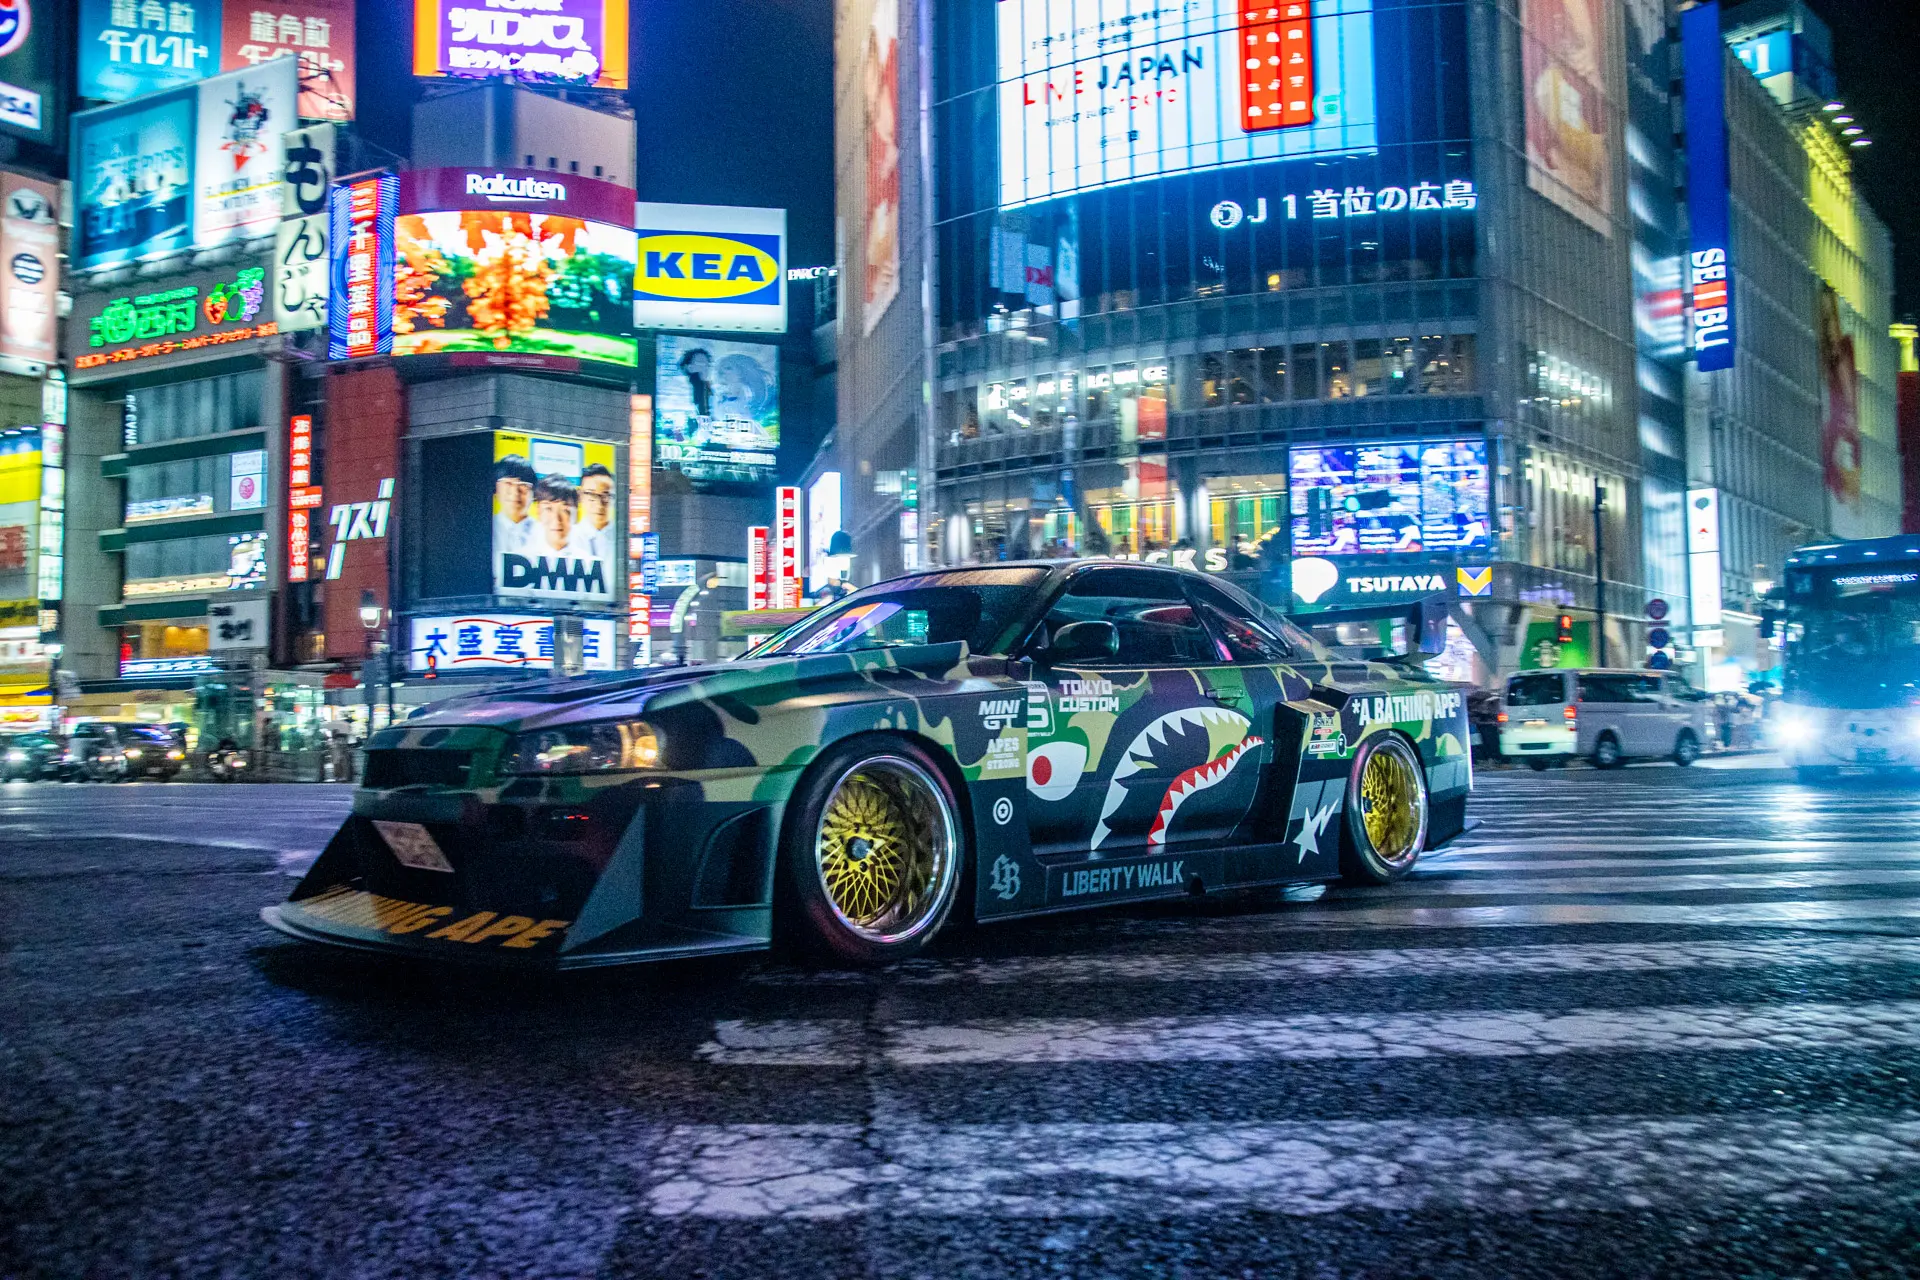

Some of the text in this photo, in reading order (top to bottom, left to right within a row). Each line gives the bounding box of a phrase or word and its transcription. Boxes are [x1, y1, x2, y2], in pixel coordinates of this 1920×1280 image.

[1097, 46, 1204, 90] JAPAN
[466, 173, 566, 201] Rakuten
[646, 251, 766, 282] KEA
[1691, 247, 1729, 352] SEIBU
[503, 552, 606, 593] DMM
[1346, 576, 1447, 593] TSUTAYA
[1059, 680, 1112, 695] TOKYO
[978, 700, 1020, 715] MINI
[1059, 697, 1119, 712] CUSTOM
[1374, 695, 1433, 724] BATHING
[983, 714, 1018, 730] GT
[986, 737, 1019, 754] APES
[986, 758, 1020, 770] STRONG
[1062, 860, 1184, 897] LIBERTY WALK
[425, 911, 569, 948] APE
